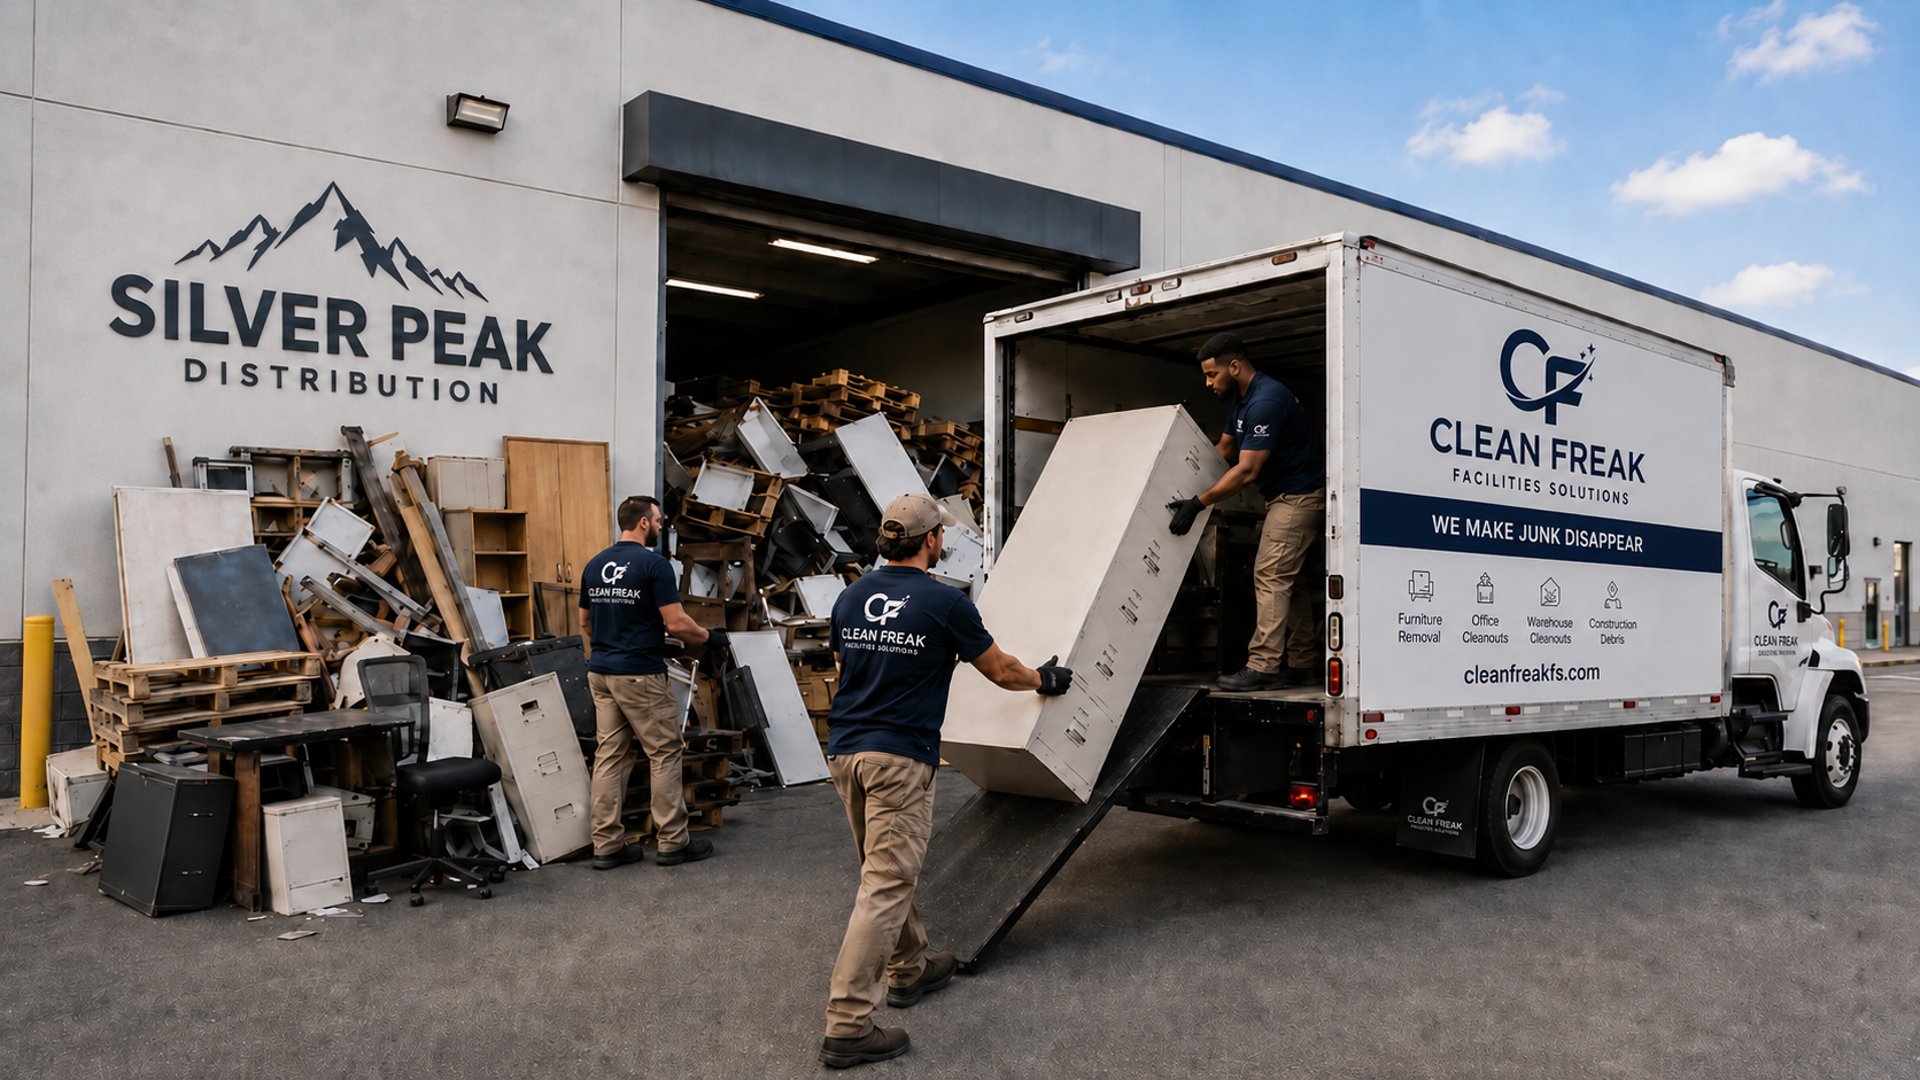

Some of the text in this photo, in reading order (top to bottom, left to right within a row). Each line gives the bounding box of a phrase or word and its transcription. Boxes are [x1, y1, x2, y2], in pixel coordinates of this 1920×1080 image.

[109, 273, 554, 374] SILVER PEAK
[184, 357, 499, 404] DISTRIBUTION
[1430, 417, 1646, 483] CLEAN FREAK
[1453, 467, 1629, 505] FACILITIES SOLUTIONS
[1431, 514, 1643, 553] WE MAKE JUNK DISAPPEAR
[588, 587, 641, 599] CLEAN FREAK
[1398, 612, 1443, 626] Furniture
[1471, 613, 1500, 627] Office
[1527, 616, 1574, 629] Warehouse
[1588, 617, 1637, 630] Construction
[841, 627, 927, 648] CLEAN FREAK
[1398, 630, 1441, 644] Removal
[1462, 631, 1509, 644] Cleanouts
[1530, 632, 1572, 645] Cleanouts
[1600, 633, 1625, 645] Debris
[1754, 635, 1798, 646] CLEAN FREAK
[1464, 663, 1600, 684] cleanfreakfs.com
[1408, 815, 1433, 825] CLEAN
[1435, 819, 1462, 830] FREAK
